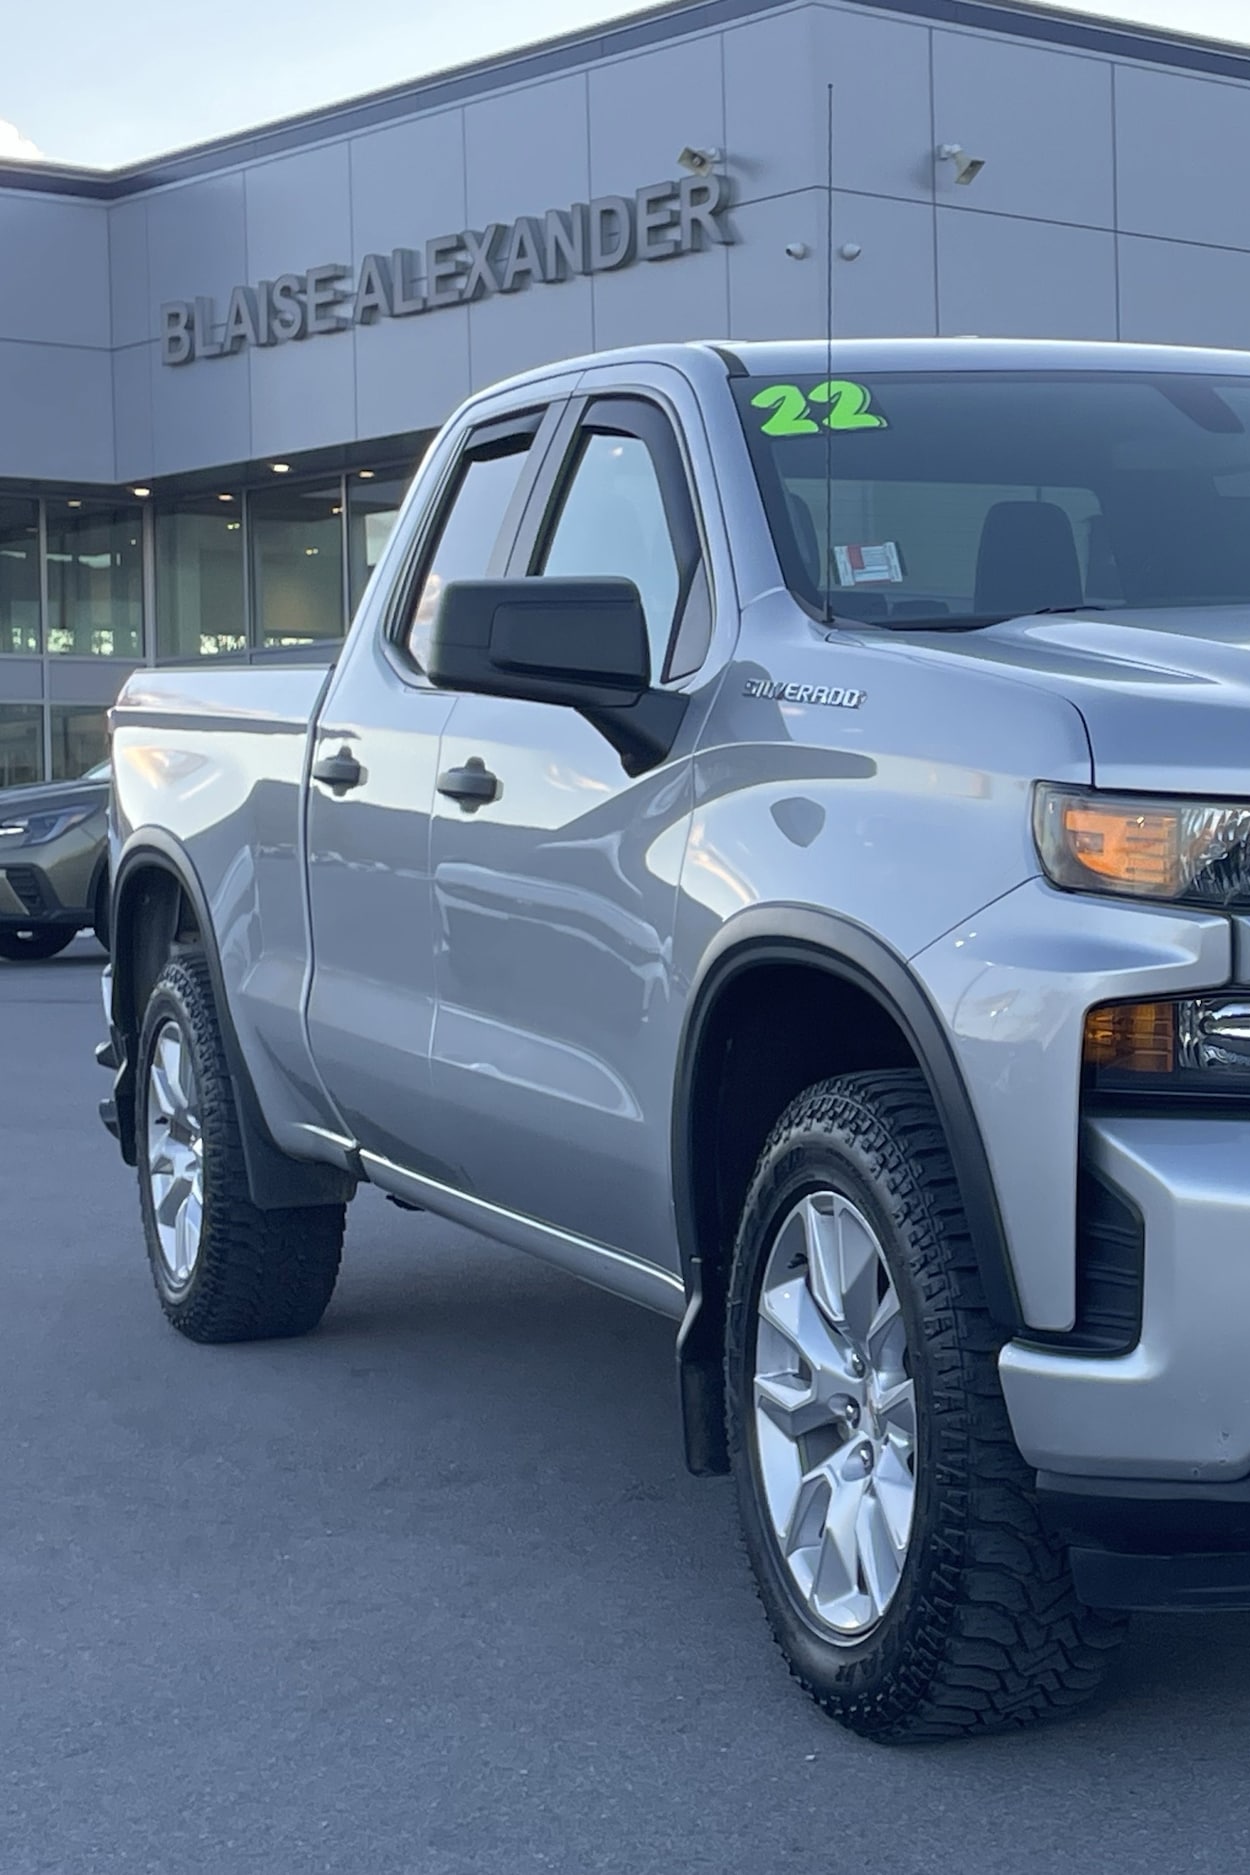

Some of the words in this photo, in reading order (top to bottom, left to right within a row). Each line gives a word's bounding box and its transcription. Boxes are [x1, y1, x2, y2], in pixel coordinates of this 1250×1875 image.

[160, 264, 349, 367] BLAISE
[353, 174, 740, 326] ALEXANDER
[751, 380, 888, 436] 22
[743, 678, 863, 709] SILVERADO
